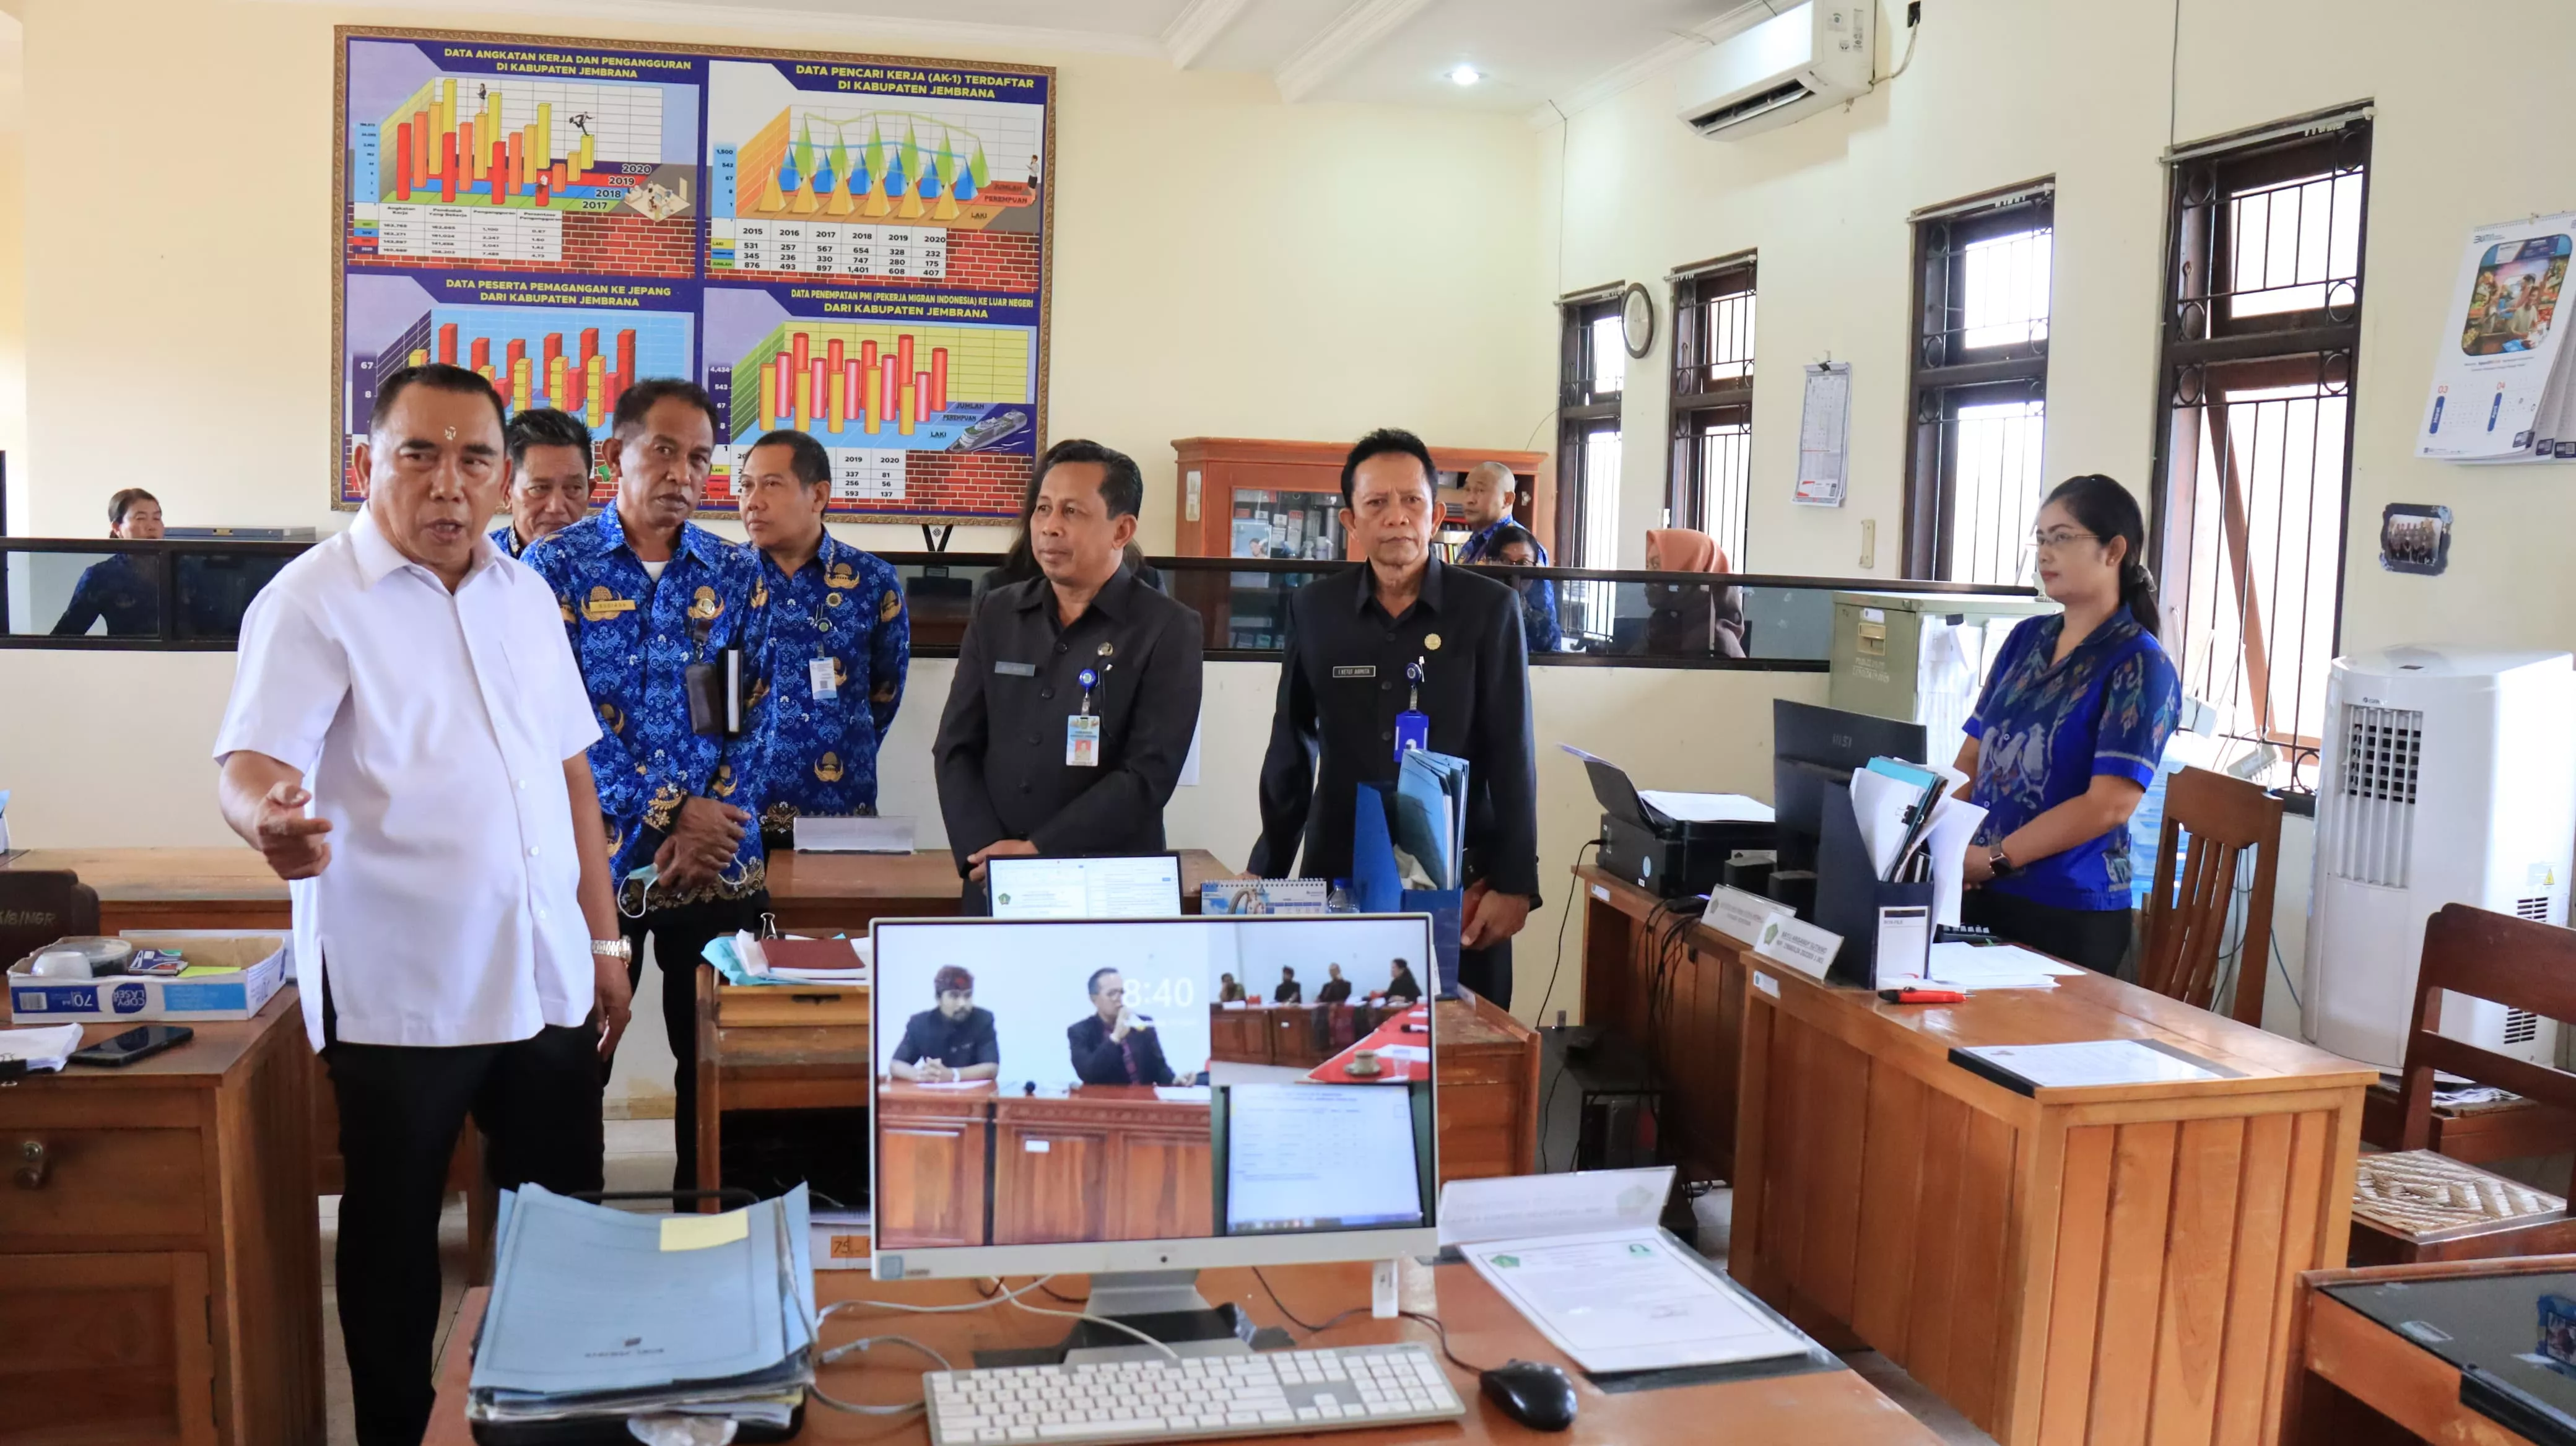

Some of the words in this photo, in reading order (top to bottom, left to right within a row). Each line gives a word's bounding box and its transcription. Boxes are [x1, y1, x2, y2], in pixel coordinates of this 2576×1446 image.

[445, 48, 473, 58] DATA
[476, 50, 536, 61] ANGKATAN
[539, 53, 573, 63] KERJA
[576, 55, 599, 64] DAN
[602, 57, 691, 69] PENGANGGURAN
[497, 63, 508, 71] DI
[511, 63, 576, 74] KABUPATEN
[579, 67, 637, 77] JEMBRANA
[796, 65, 828, 76] DATA
[831, 67, 884, 78] PENCARI
[887, 71, 925, 81] KERJA
[928, 73, 961, 84] (AK-1)
[965, 75, 1034, 88] TERDAFTAR
[838, 81, 851, 89] DI
[854, 82, 927, 94] KABUPATEN
[930, 86, 995, 98] JEMBRANA
[622, 164, 651, 173] 2020
[609, 176, 635, 185] 2019
[596, 189, 622, 198] 2018
[985, 195, 1027, 204] PEREMPUAN
[446, 279, 476, 289] DATA
[478, 281, 527, 290] PESERTA
[530, 283, 607, 294] PEMAGANGAN
[611, 285, 625, 294] KE
[629, 287, 671, 296] JEPANG
[481, 292, 507, 301] DARI
[510, 294, 577, 304] KABUPATEN
[580, 296, 640, 307] JEMBRANA
[791, 289, 809, 298] DATA
[811, 290, 858, 300] PENEMPATAN
[874, 292, 907, 302] (PEKERJA
[908, 294, 935, 303] MIGRAN
[937, 295, 977, 306] INDONESIA)
[989, 298, 1007, 307] LUAR
[1009, 299, 1033, 307] NEGERI
[824, 303, 851, 312] DARI
[855, 304, 923, 315] KABUPATEN
[926, 308, 988, 318] JEMBRANA
[365, 390, 372, 398] 8
[2438, 385, 2448, 393] 03
[114, 990, 145, 998] LASER
[1121, 977, 1194, 1008] 8:40
[74, 994, 93, 1007] 70
[118, 998, 145, 1007] COPY
